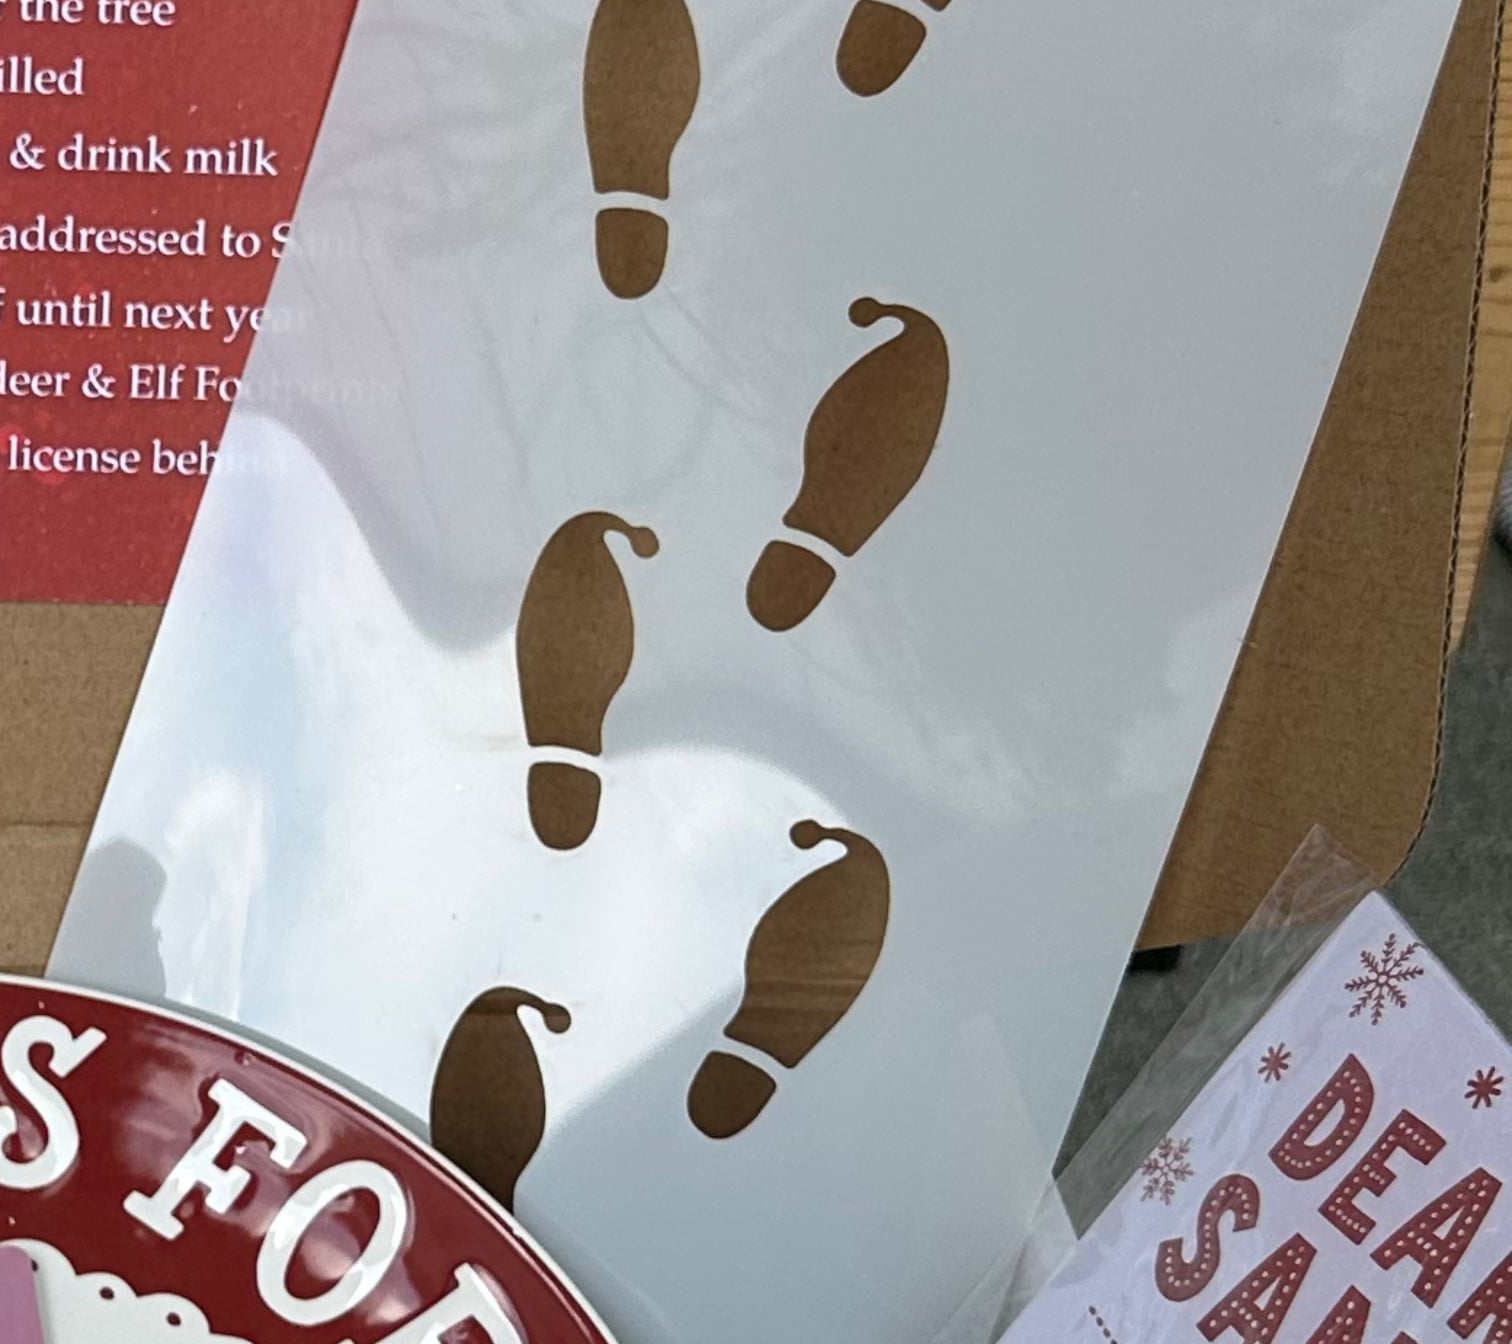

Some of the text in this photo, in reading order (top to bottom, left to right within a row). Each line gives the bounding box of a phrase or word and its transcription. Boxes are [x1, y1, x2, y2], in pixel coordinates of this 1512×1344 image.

[9, 132, 46, 169] &
[57, 131, 172, 173] drink
[184, 137, 278, 176] milk
[221, 224, 261, 257] to
[16, 290, 111, 327] until
[124, 299, 214, 330] next
[224, 304, 282, 343] ye
[82, 363, 117, 398] &
[128, 363, 186, 400] Elf
[8, 434, 141, 474] license
